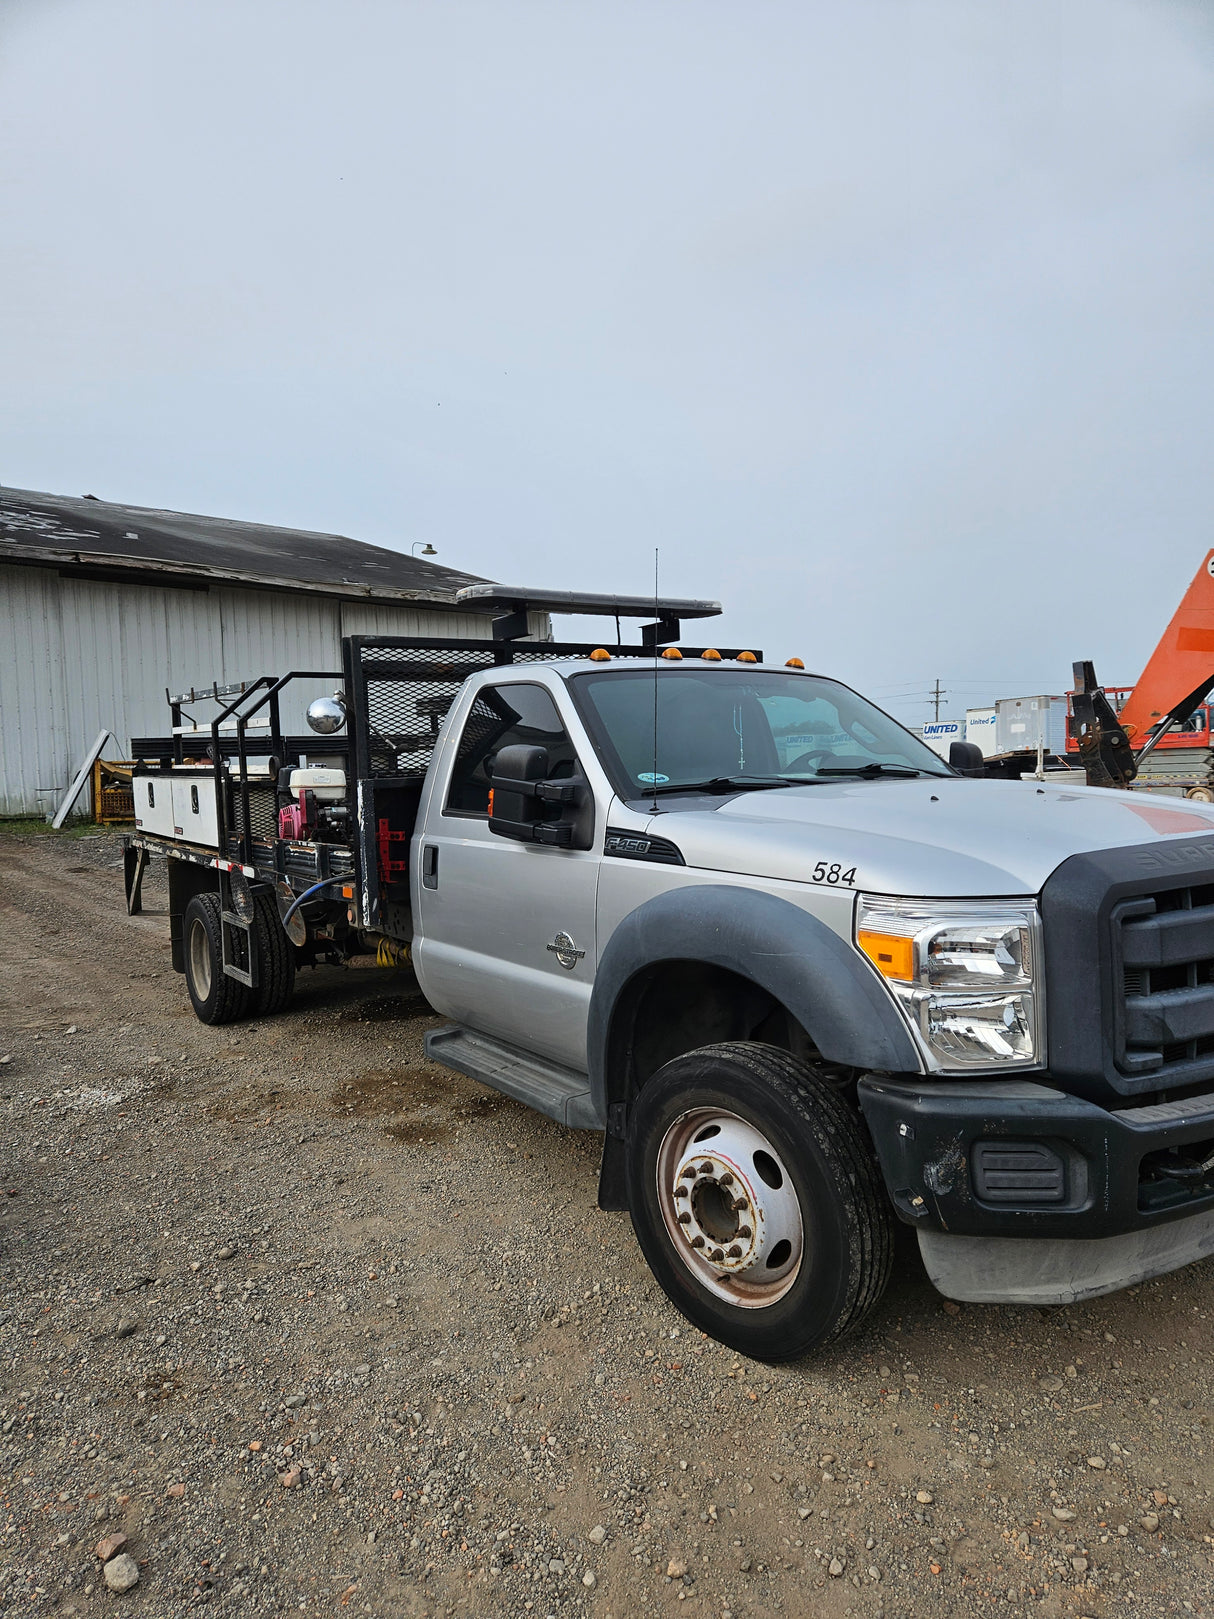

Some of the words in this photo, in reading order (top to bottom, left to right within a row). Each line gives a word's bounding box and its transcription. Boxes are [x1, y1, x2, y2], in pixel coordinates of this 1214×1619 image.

[970, 717, 990, 726] United
[923, 724, 958, 734] UNITED
[786, 735, 814, 744] UNITED
[812, 861, 857, 886] 584
